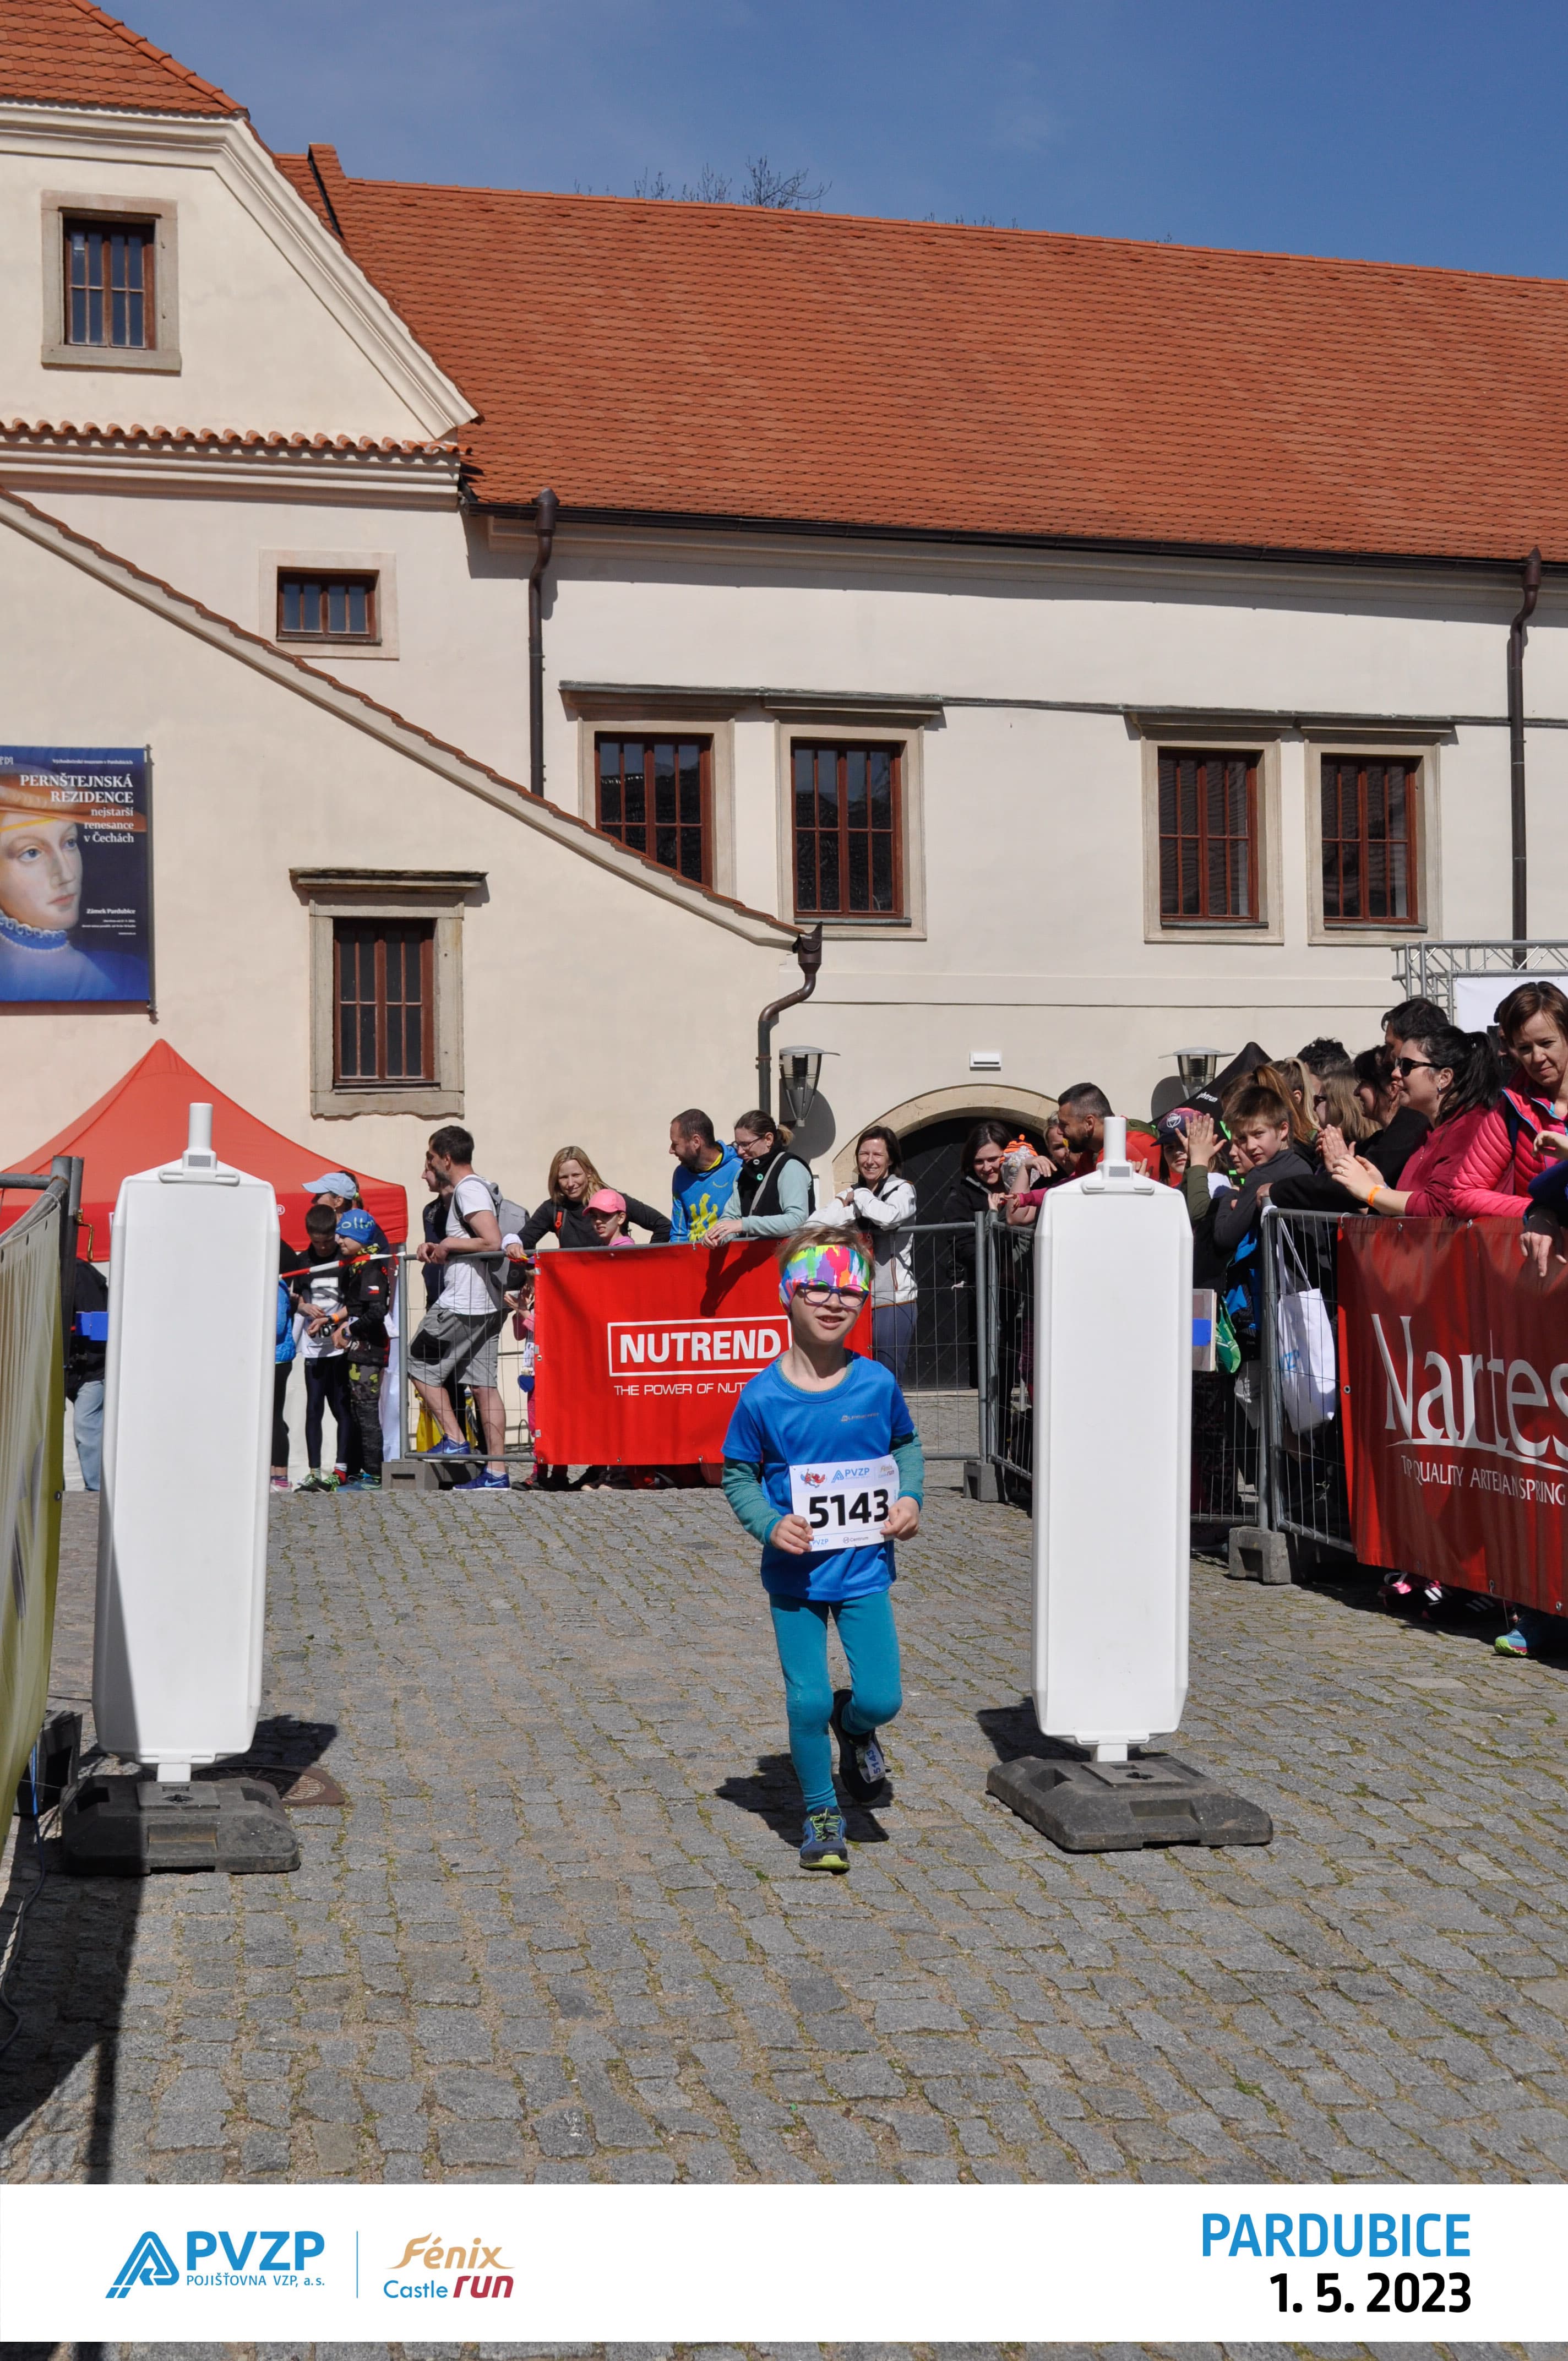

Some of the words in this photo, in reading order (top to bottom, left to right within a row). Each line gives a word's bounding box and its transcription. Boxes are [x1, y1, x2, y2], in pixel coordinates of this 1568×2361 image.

[20, 773, 133, 788] PERNŠTEJNSKÁ
[50, 791, 134, 803] REZIDENCE
[91, 807, 134, 818] nejstarší
[84, 822, 134, 830] renesance
[92, 831, 134, 842] Čechách
[620, 1329, 781, 1363] NUTREND
[614, 1385, 639, 1396] THE
[644, 1383, 692, 1396] POWER
[696, 1383, 714, 1394] OF
[717, 1382, 748, 1394] NUT
[845, 1467, 870, 1477] PVZP
[1413, 1460, 1464, 1487] QUALITY
[1518, 1478, 1566, 1506] SPRING
[809, 1488, 889, 1529] 5143
[866, 1750, 881, 1774] 5143
